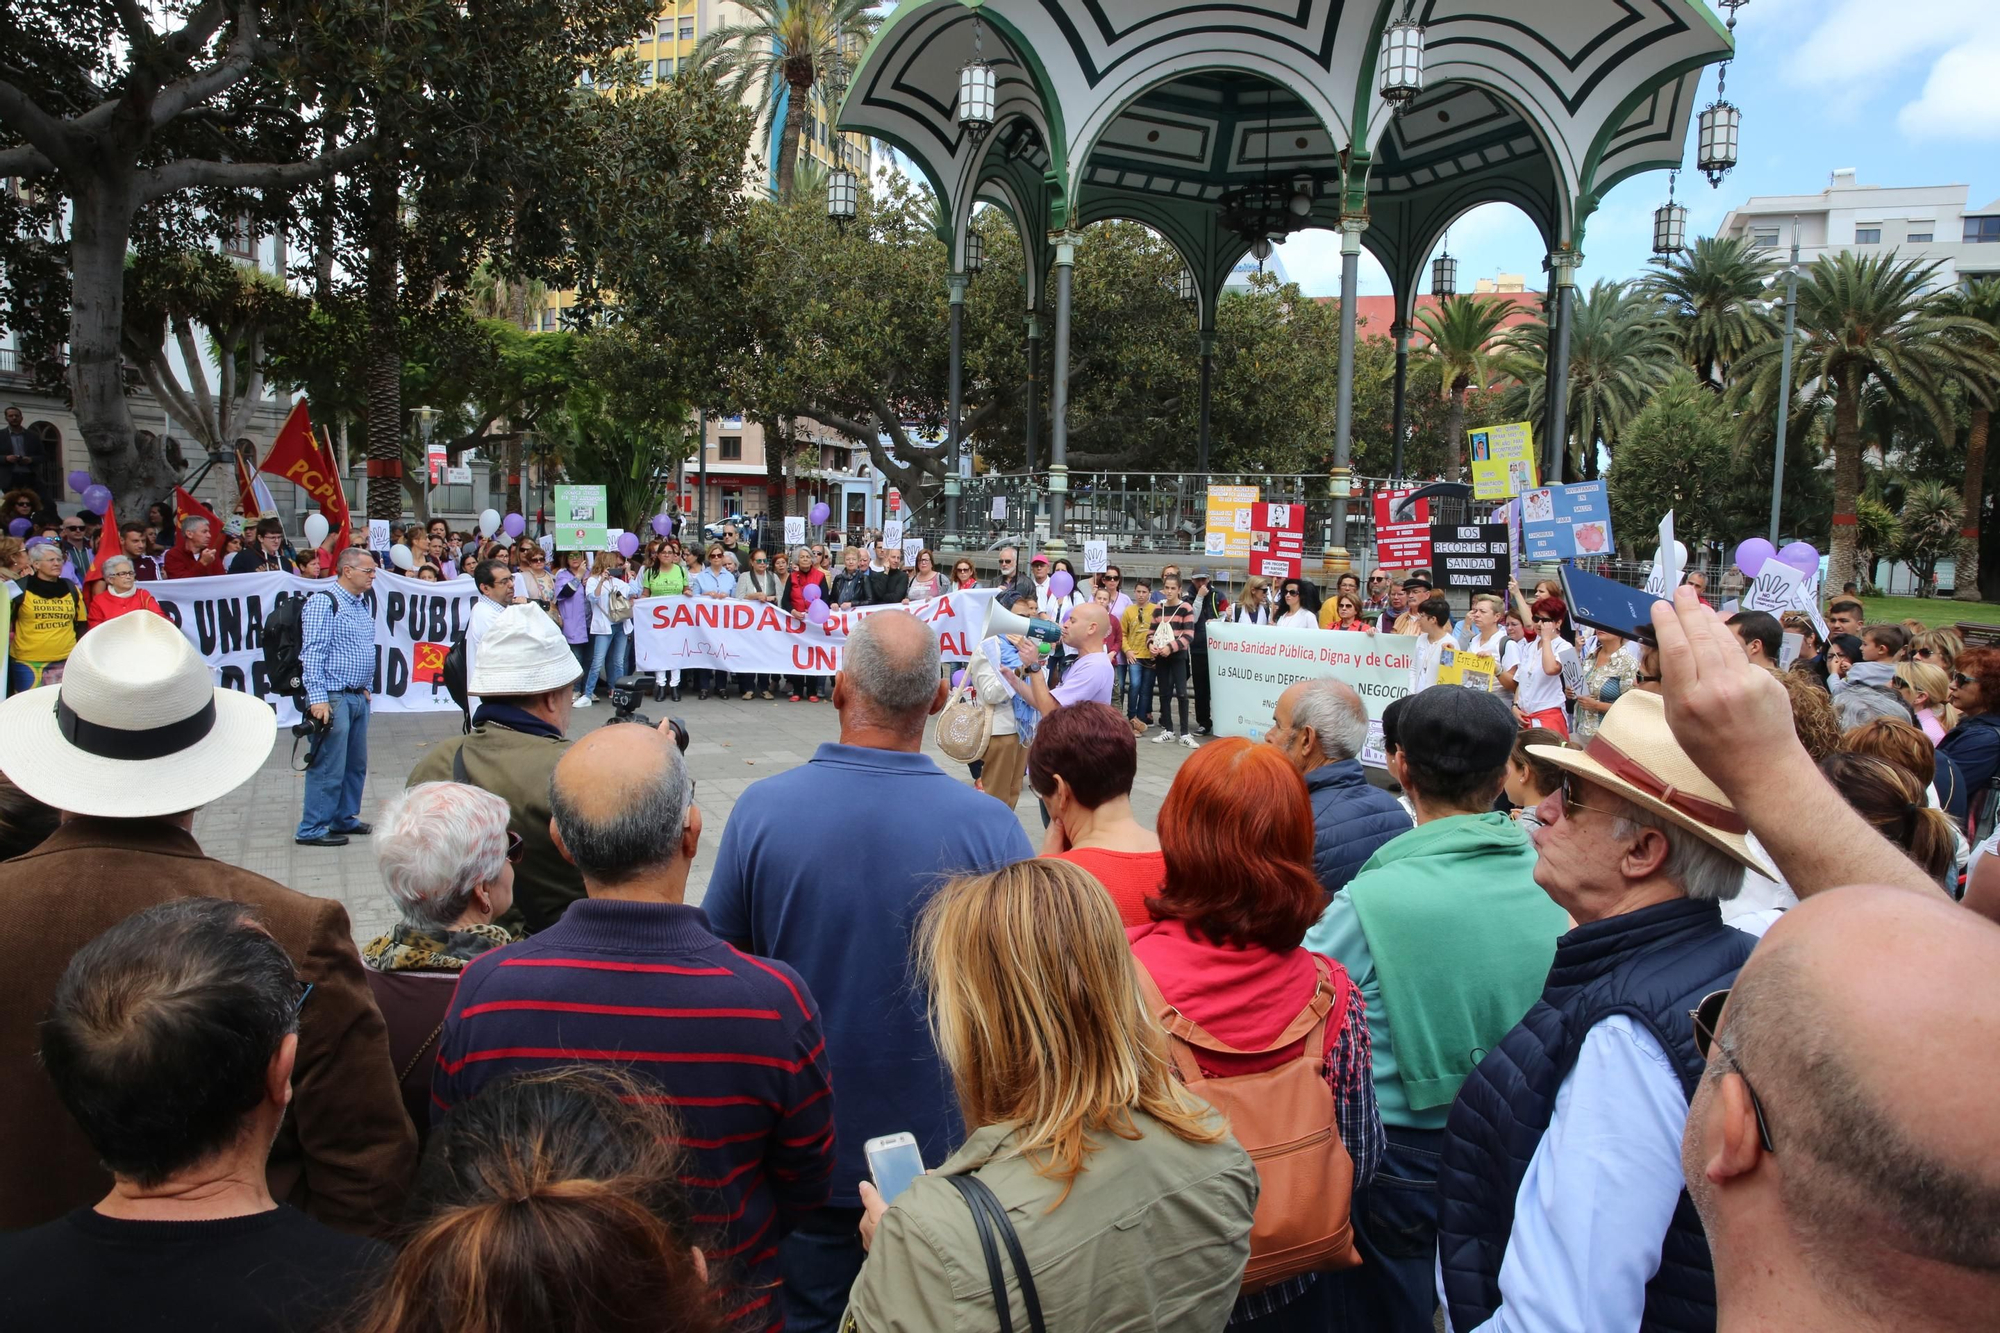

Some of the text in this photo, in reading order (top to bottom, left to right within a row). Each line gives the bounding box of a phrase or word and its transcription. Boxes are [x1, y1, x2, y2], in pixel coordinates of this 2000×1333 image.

[1459, 528, 1478, 538] LOS
[1435, 543, 1506, 553] RECORTES EN
[1448, 558, 1494, 569] SANIDAD
[1451, 575, 1490, 584] MATAN
[1627, 601, 1638, 618] SONY
[652, 604, 809, 634] SANIDAD
[1208, 638, 1221, 650] Por
[1223, 641, 1238, 652] una
[1241, 641, 1276, 656] Sanidad
[1279, 644, 1317, 662] Pública,
[1320, 649, 1350, 666] Digna
[1354, 655, 1362, 668] y
[1366, 652, 1381, 667] de
[1218, 666, 1226, 677] La
[1228, 666, 1252, 680] SALUD
[1254, 673, 1263, 682] es
[1265, 674, 1275, 684] un
